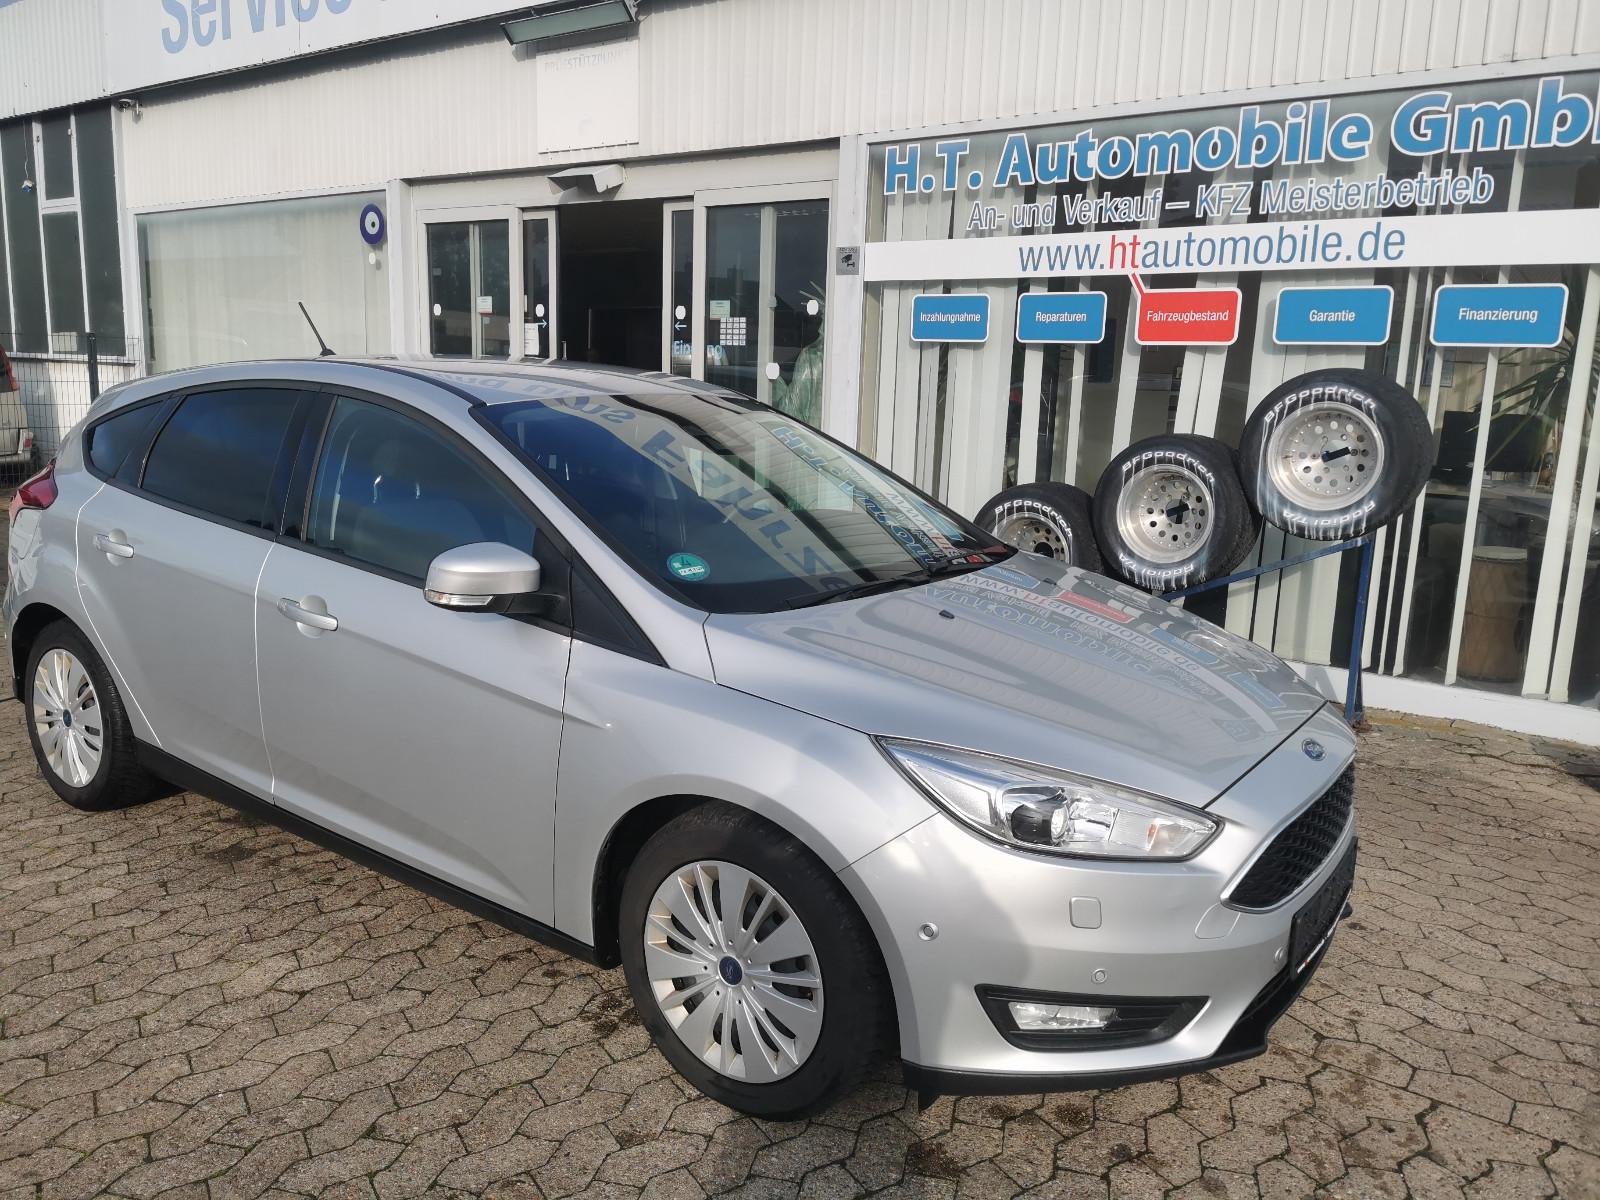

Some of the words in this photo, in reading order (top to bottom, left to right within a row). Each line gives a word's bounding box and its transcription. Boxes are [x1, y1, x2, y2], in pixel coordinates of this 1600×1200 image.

[884, 139, 983, 195] H.T.
[994, 98, 1373, 188] Automobile
[1391, 75, 1600, 156] Gmb
[967, 201, 1006, 231] An-
[1012, 201, 1056, 228] und
[1063, 188, 1163, 226] Verkauf
[1196, 181, 1254, 218] KFZ
[1259, 166, 1495, 215] Meisterbetrieb
[1019, 221, 1406, 272] www.htautomobile.de
[919, 311, 981, 324] Inzahlungnahme
[1035, 311, 1087, 324] Reparaturen
[1146, 309, 1229, 323] Fahrzeugbestand
[1309, 309, 1356, 323] Garantie
[1458, 307, 1539, 324] Finanzierung
[1264, 385, 1376, 422] BFGoodrich
[1122, 451, 1215, 483] BFGoodrich
[994, 500, 1073, 537] BFGoodrich
